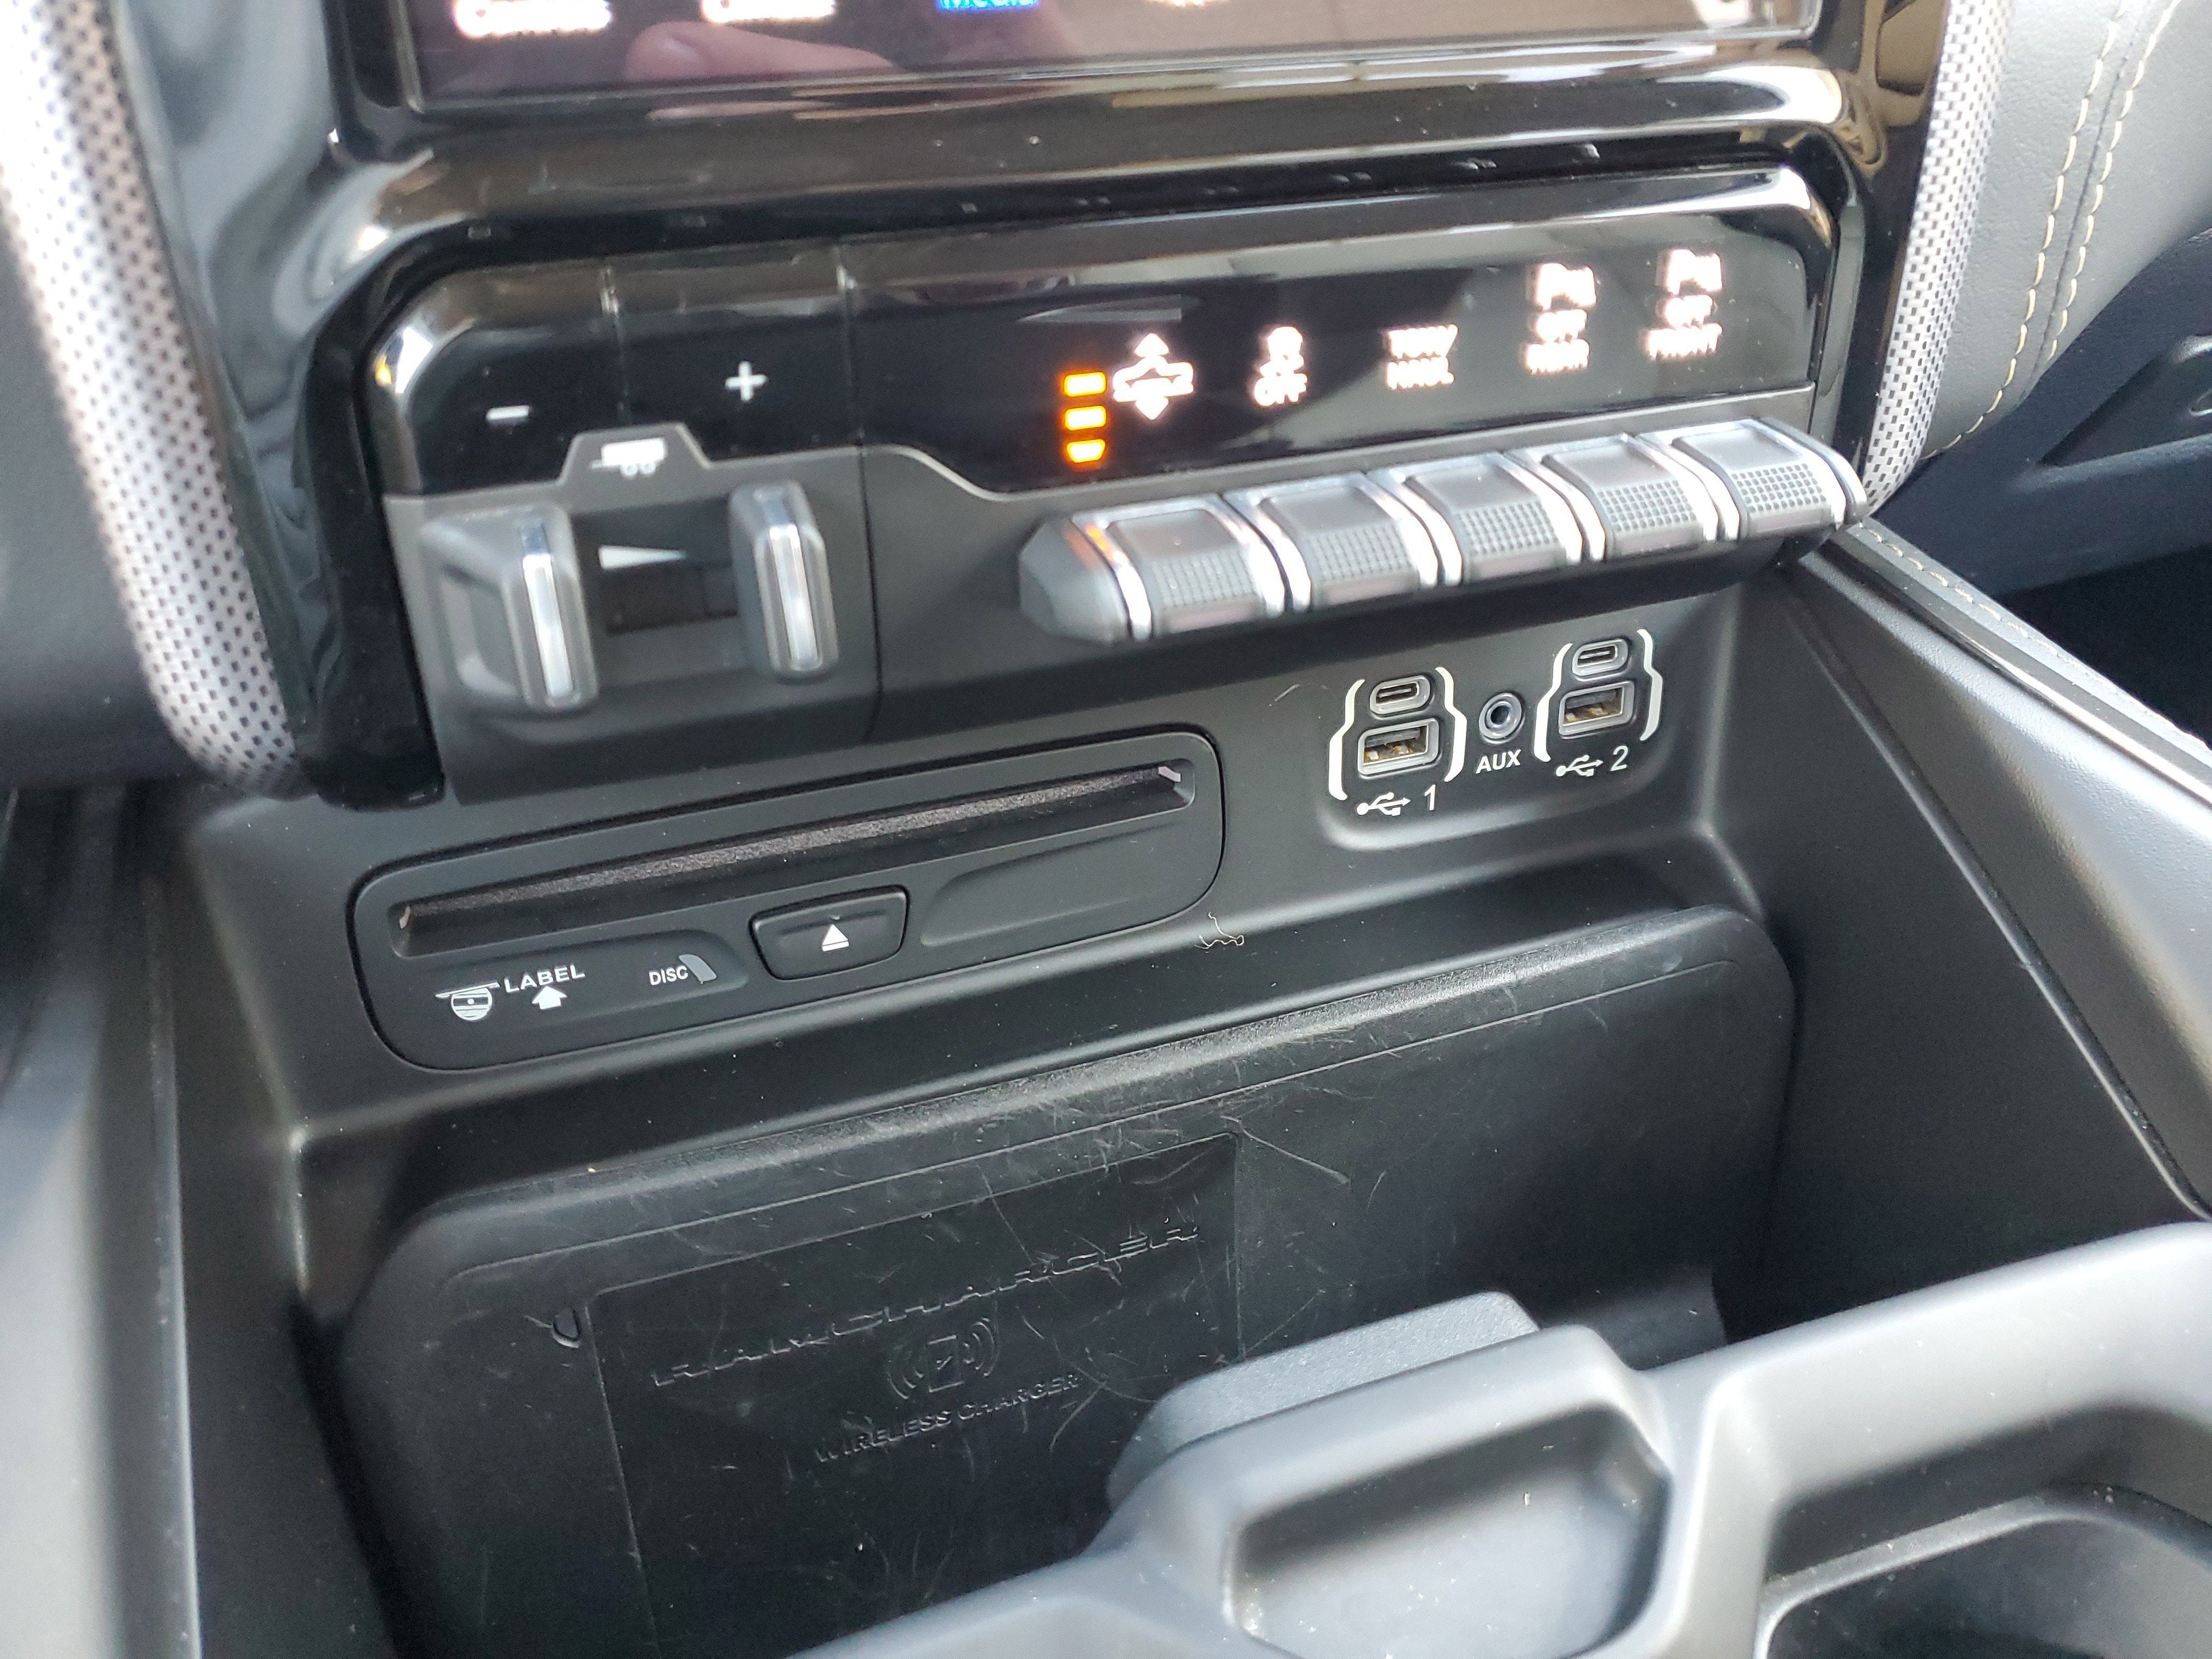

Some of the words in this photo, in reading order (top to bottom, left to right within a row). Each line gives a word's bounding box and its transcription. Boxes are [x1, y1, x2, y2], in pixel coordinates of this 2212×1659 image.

[1476, 749, 1521, 774] AUX
[1611, 745, 1628, 771] 2
[1425, 784, 1436, 811] 1
[504, 964, 586, 994] LABEL
[648, 965, 689, 986] DISC
[815, 1410, 951, 1463] WIRELESS
[958, 1374, 1082, 1421] CHARGER
